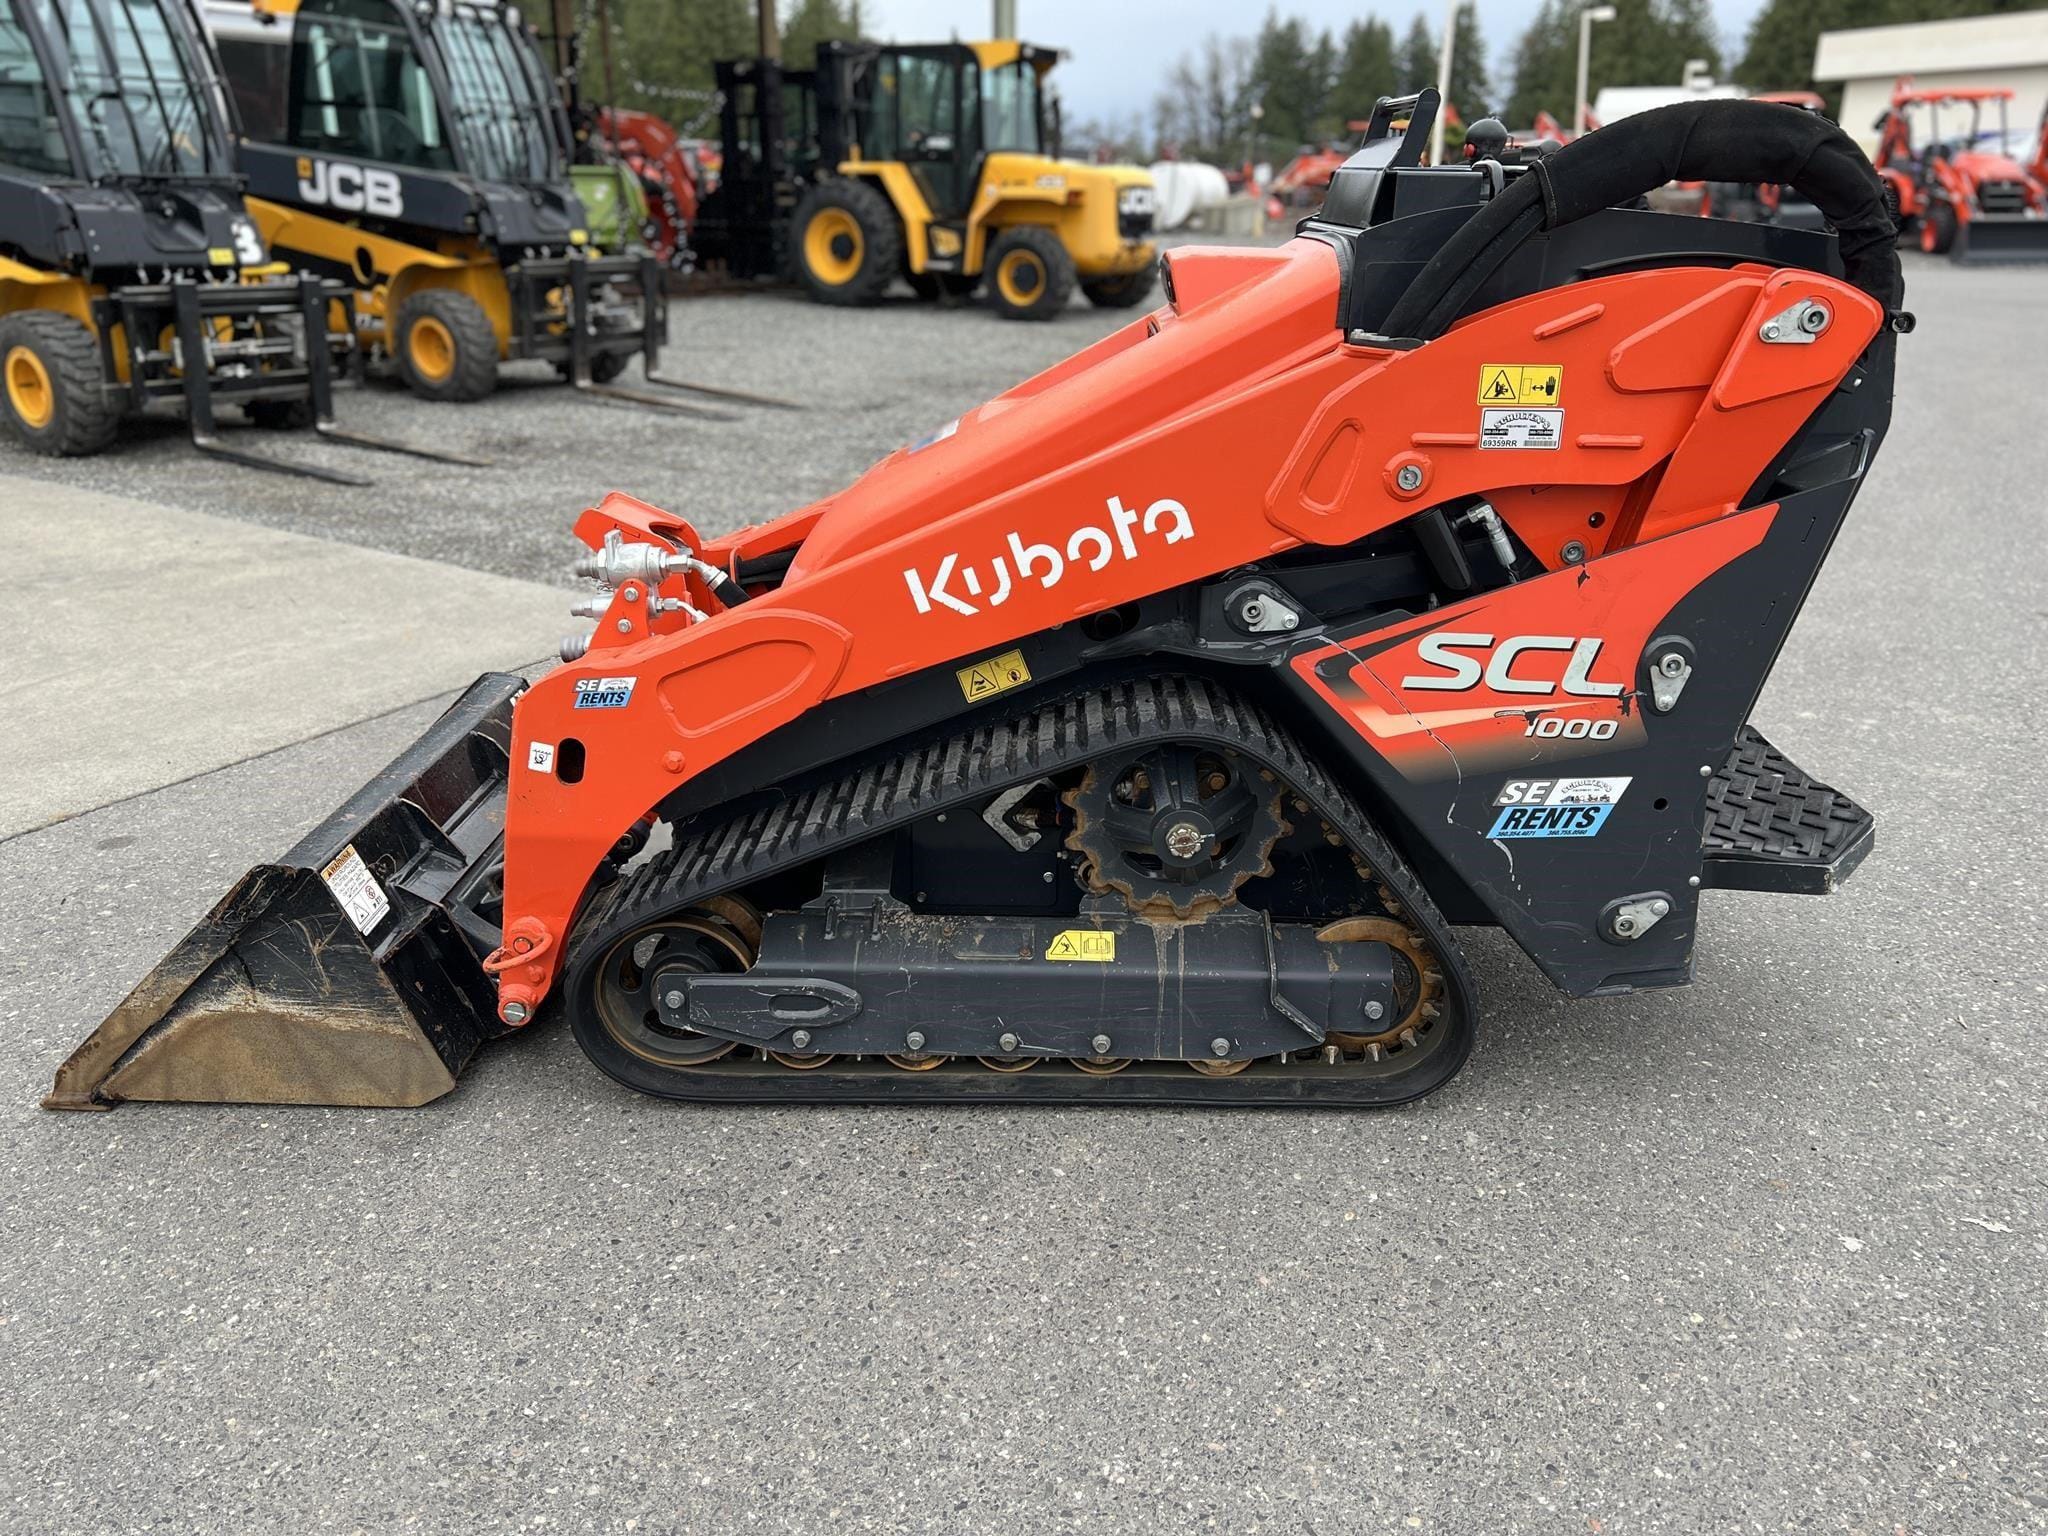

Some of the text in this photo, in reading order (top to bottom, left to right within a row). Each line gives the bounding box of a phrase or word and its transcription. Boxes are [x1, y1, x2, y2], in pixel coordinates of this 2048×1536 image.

[298, 158, 404, 218] JCB
[1482, 439, 1518, 447] 69359RR
[903, 495, 1195, 617] Kubota
[1400, 632, 1626, 697] SCL
[575, 679, 599, 691] SE
[580, 691, 626, 704] RENTS
[1499, 781, 1552, 804] SE
[1501, 806, 1601, 830] RENTS
